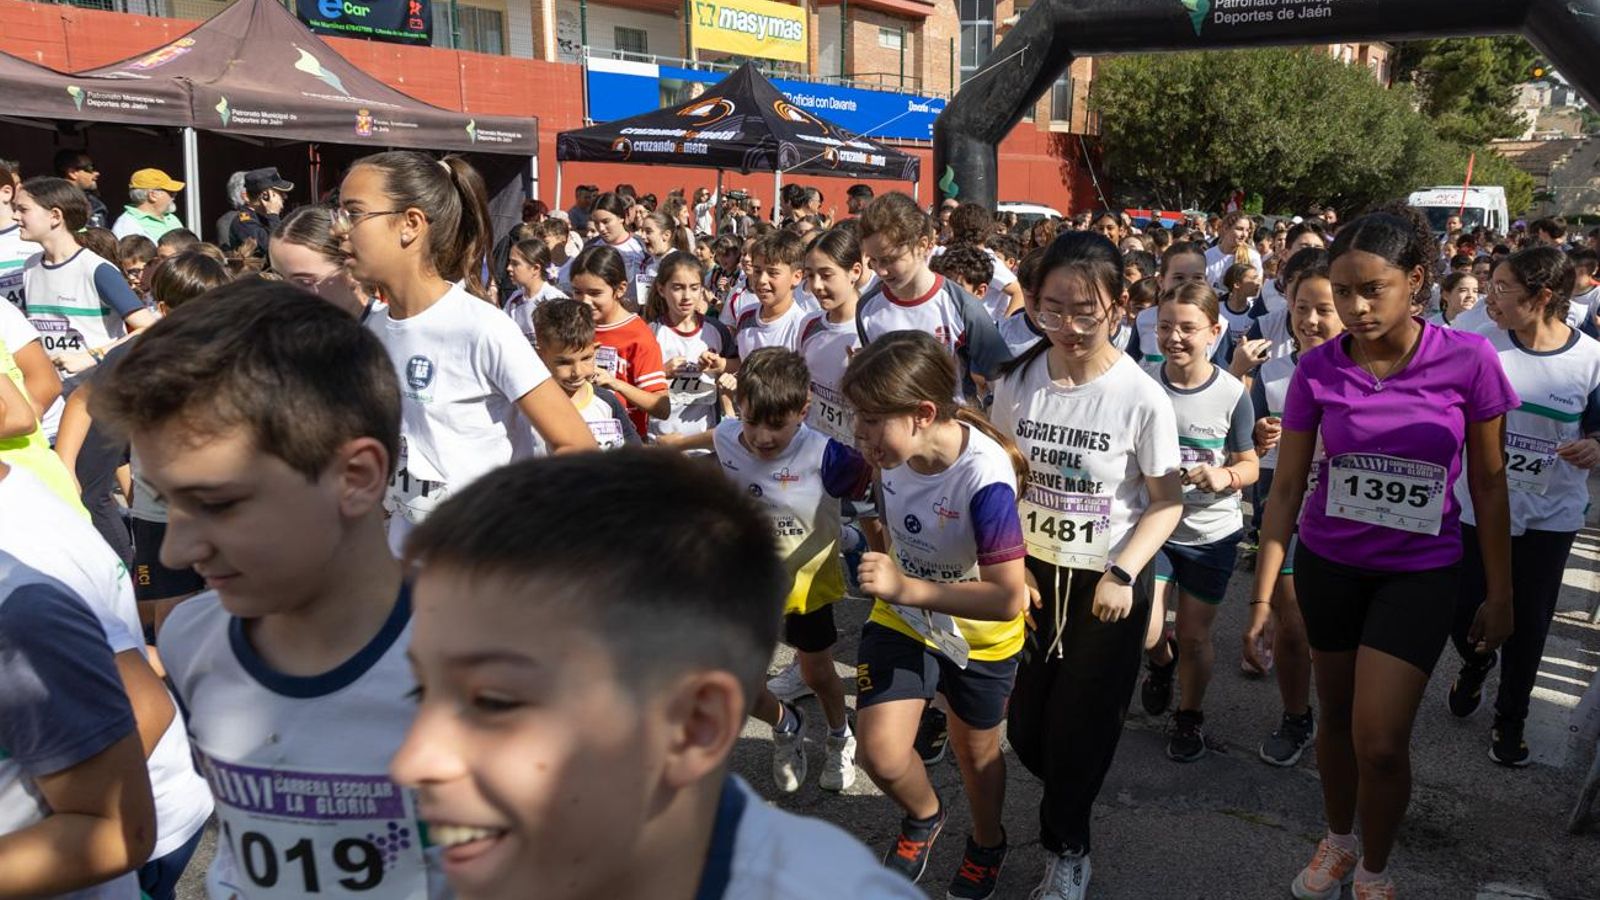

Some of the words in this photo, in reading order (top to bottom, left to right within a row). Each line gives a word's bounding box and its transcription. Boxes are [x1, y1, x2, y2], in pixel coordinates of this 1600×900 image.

[719, 6, 802, 41] masymas
[1214, 10, 1274, 25] Deportes
[1277, 8, 1295, 20] de
[1297, 4, 1332, 19] Jaén
[87, 99, 119, 109] Deportes
[231, 108, 260, 118] Patronato
[261, 111, 289, 120] Municipal
[793, 94, 815, 107] oficial
[816, 97, 829, 109] con
[829, 97, 857, 112] Davante
[231, 115, 260, 124] Deportes
[44, 336, 81, 350] 044
[820, 401, 842, 427] 751
[1016, 417, 1111, 452] SOMETIMES
[1030, 446, 1082, 470] PEOPLE
[1026, 470, 1062, 490] SERVE
[1344, 475, 1429, 508] 1395
[1026, 510, 1094, 544] 1481
[138, 564, 151, 586] MCI
[941, 570, 963, 579] DE
[857, 663, 874, 692] MCI
[274, 775, 330, 797] CARRERA
[332, 782, 394, 800] ESCOLAR
[286, 793, 306, 812] LA
[316, 797, 378, 815] GLORIA
[224, 819, 384, 892] 019
